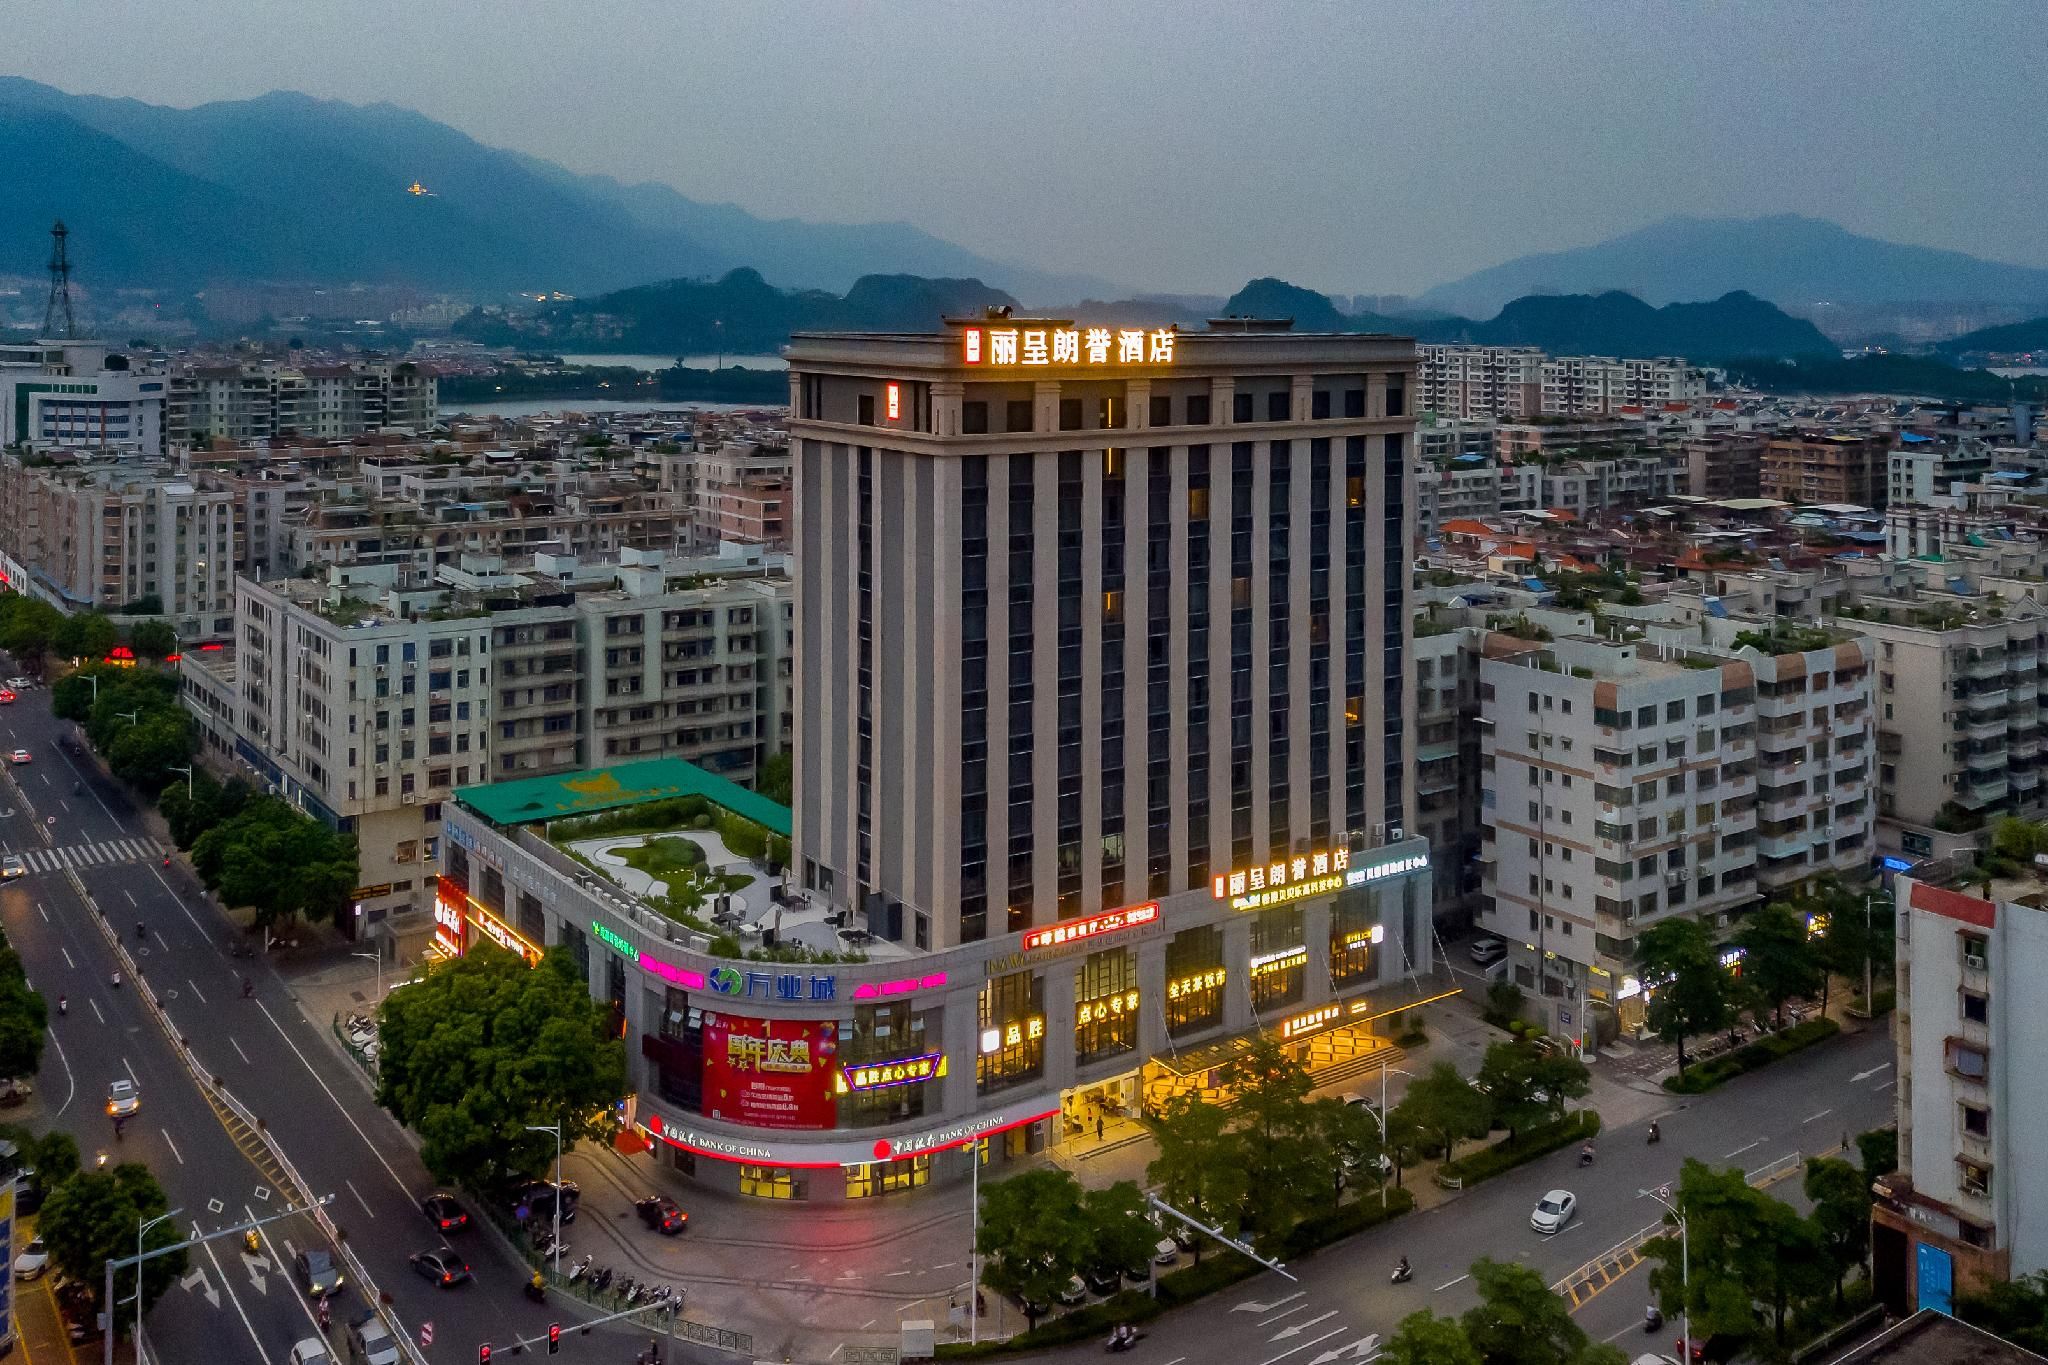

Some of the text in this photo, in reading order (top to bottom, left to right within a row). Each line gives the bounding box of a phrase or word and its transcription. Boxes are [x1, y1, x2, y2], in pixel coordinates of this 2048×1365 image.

[989, 329, 1175, 365] 丽呈朗誉酒店
[1229, 849, 1349, 896] 丽呈朗誉酒店
[746, 971, 836, 1000] 万业城
[1078, 991, 1139, 1024] 点心专家
[1007, 1019, 1043, 1046] 品胜
[728, 1034, 809, 1073] 周年庆典
[663, 1124, 771, 1158] 中国银行 BANK OF CHINA
[893, 1116, 1004, 1154] 中国银行 BANK OF CHINA
